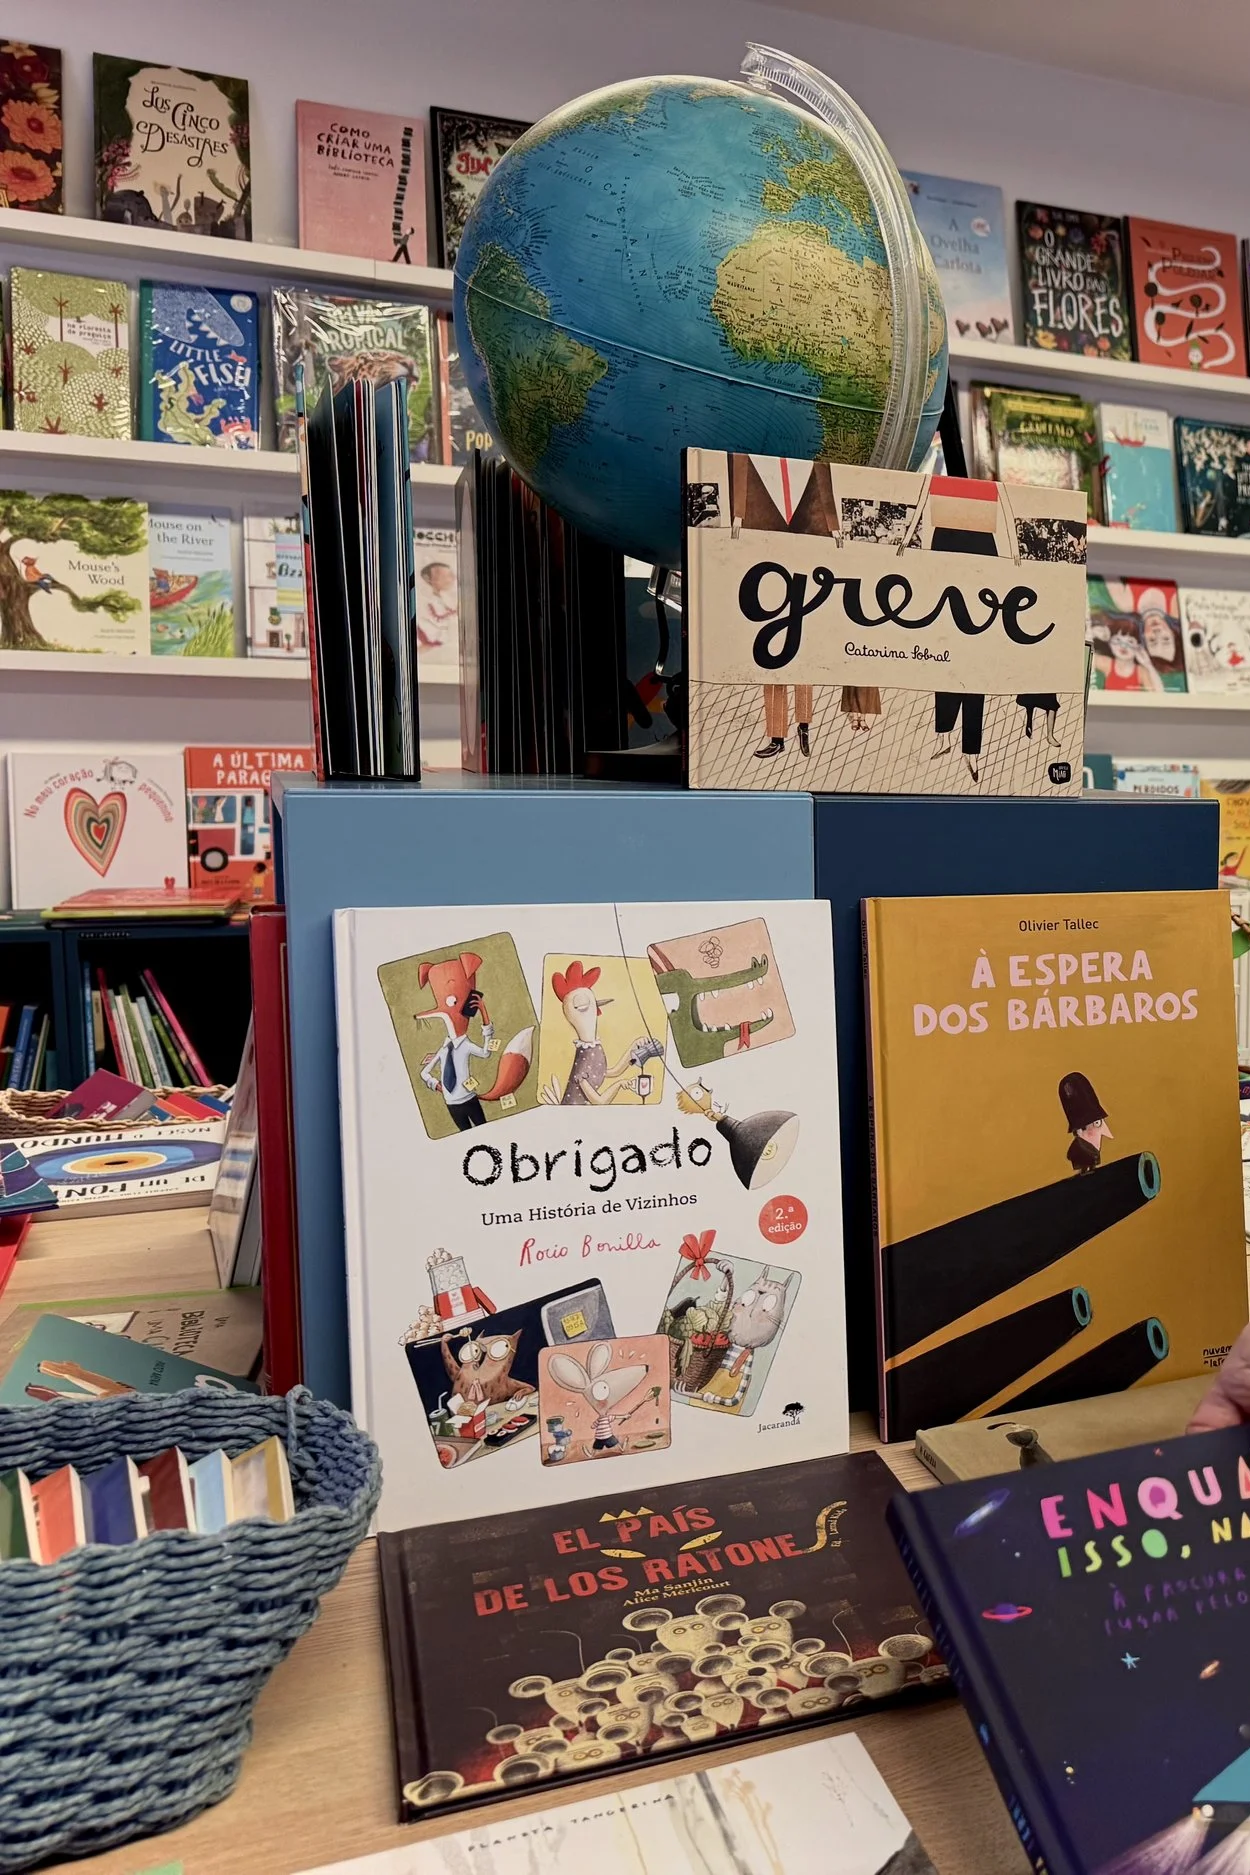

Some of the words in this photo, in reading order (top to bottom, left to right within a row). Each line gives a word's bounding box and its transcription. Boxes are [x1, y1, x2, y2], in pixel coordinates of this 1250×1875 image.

[330, 123, 370, 139] COMO
[364, 142, 391, 155] UMA
[948, 218, 960, 232] A
[931, 234, 980, 255] Ovelha
[1044, 229, 1055, 247] O
[933, 254, 983, 275] Carlota
[1035, 247, 1096, 274] GRANDE
[1036, 266, 1085, 292] LIVRO
[1032, 288, 1123, 338] FLORES
[169, 340, 222, 362] LITTLE
[186, 522, 202, 532] on
[157, 532, 178, 544] the
[181, 533, 214, 547] River
[68, 559, 120, 573] Mouse's
[88, 573, 125, 586] Wood
[738, 561, 1056, 670] greve
[844, 641, 909, 660] Catarina
[213, 753, 224, 769] A
[230, 751, 305, 770] ÚLTIMA
[217, 770, 271, 787] PARAG
[1133, 783, 1180, 794] PERDIDOS
[1018, 918, 1060, 932] Olivier
[1063, 918, 1099, 931] Tallec
[971, 948, 996, 989] À
[1009, 950, 1153, 987] ESPERA
[913, 1001, 989, 1036] DOS
[1007, 988, 1199, 1031] BÁRBAROS
[20, 1133, 123, 1150] MUNDO
[462, 1127, 712, 1192] Obrigado
[140, 1179, 168, 1188] UM
[185, 1175, 206, 1184] DE
[481, 1210, 523, 1227] Uma
[528, 1203, 596, 1223] História
[601, 1198, 622, 1215] de
[625, 1192, 698, 1211] Vizinhos
[768, 1222, 802, 1234] edição
[582, 1232, 661, 1258] Bonilla
[757, 1417, 801, 1433] Jacarandá
[552, 1528, 602, 1555] EL
[616, 1504, 717, 1545] PAÍS
[1058, 1529, 1191, 1578] ISSO,
[473, 1583, 530, 1617] DE
[543, 1565, 629, 1604] LOS
[623, 1593, 662, 1608] Alice
[662, 1579, 731, 1600] Méricourt
[634, 1585, 660, 1598] Ma
